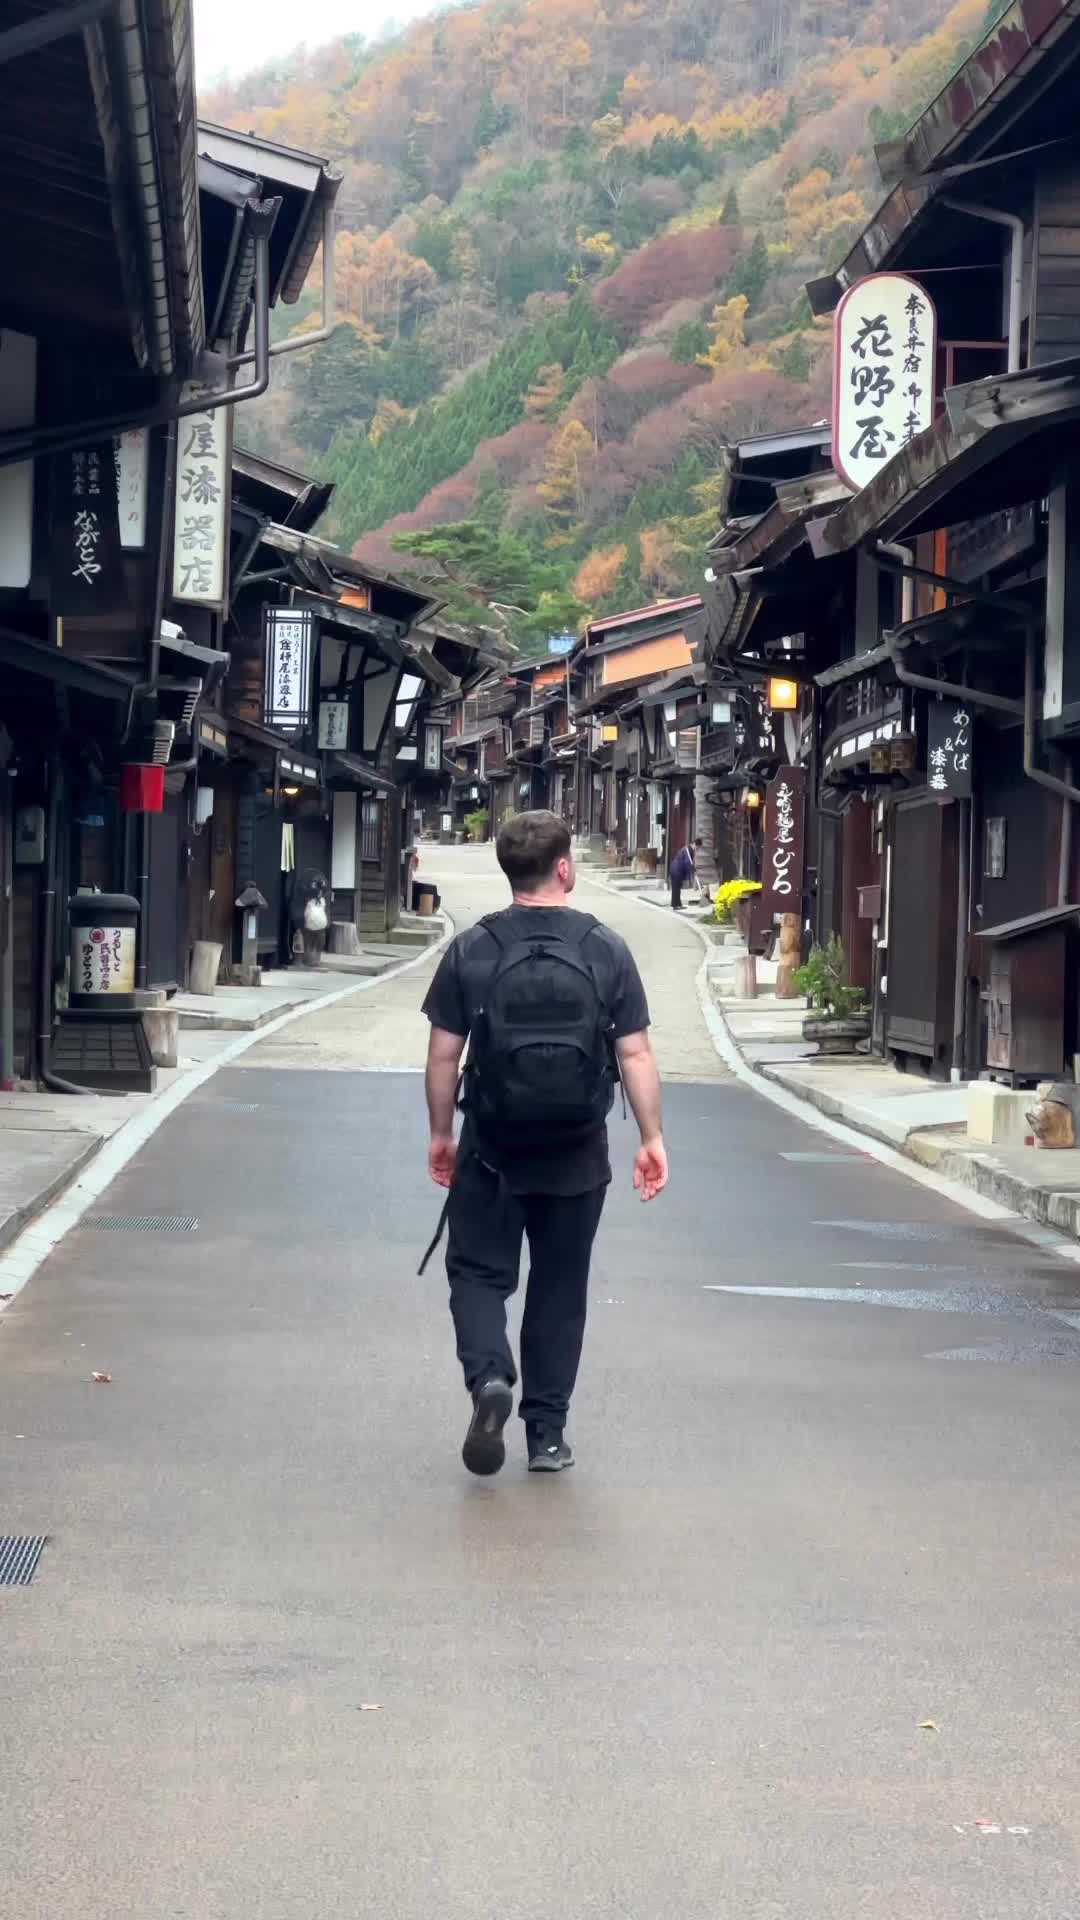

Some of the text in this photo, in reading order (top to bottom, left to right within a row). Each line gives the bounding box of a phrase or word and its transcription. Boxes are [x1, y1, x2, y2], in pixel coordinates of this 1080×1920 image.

[902, 292, 926, 374] 奈良井宿
[849, 313, 895, 460] 花野屋
[179, 382, 221, 593] 屋漆器店
[72, 509, 102, 585] ながとや
[929, 746, 948, 790] 漆の器
[945, 737, 954, 751] &
[953, 709, 970, 771] めんば
[82, 943, 94, 992] ゆとうや
[112, 929, 122, 972] うるしと
